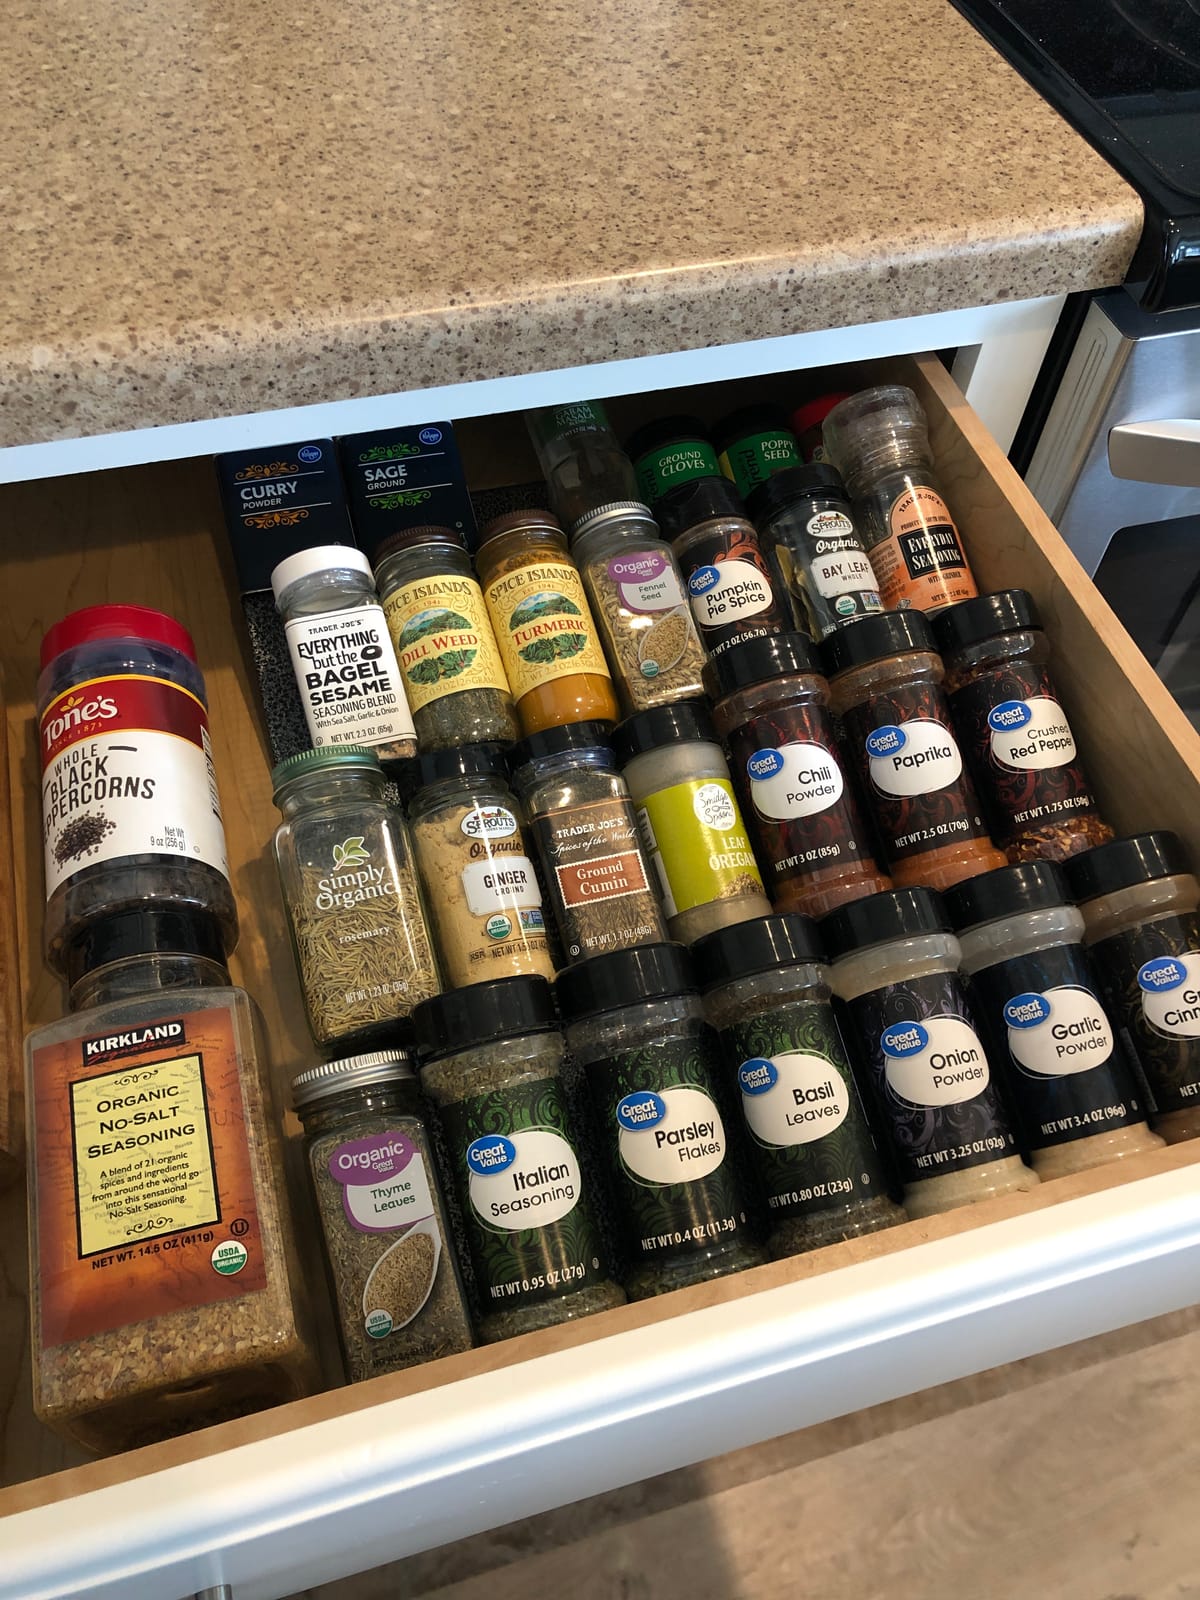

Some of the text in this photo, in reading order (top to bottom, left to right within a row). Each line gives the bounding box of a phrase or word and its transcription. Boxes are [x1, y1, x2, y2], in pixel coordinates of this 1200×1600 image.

[761, 440, 793, 452] POPPY
[764, 450, 790, 460] SEED
[659, 451, 701, 467] GROUND
[661, 459, 705, 477] CLOVES
[364, 465, 408, 481] SAGE
[240, 481, 297, 501] CURRY
[367, 479, 406, 490] GROUND
[243, 497, 282, 510] POWDER
[812, 520, 851, 534] SPROUTS
[816, 538, 859, 553] Organic
[614, 558, 659, 574] Organic
[822, 562, 869, 579] BAY LEAF
[412, 582, 472, 600] ISLANDS
[490, 568, 579, 604] SPICE ISLANDS
[638, 582, 666, 592] Fennel
[706, 581, 762, 606] Pumpkin
[641, 592, 661, 601] Seed
[708, 592, 766, 619] Pie Spice
[308, 620, 362, 635] TRADER JOE'S
[512, 620, 588, 646] TURMERIC
[741, 628, 768, 642] (56.7g)
[297, 629, 379, 658] EVERYTHING
[402, 634, 478, 668] DILL WEED
[313, 650, 358, 670] but the
[306, 660, 388, 690] BAGEL
[310, 678, 392, 706] SESAME
[313, 694, 396, 720] SEASONING BLEND
[993, 706, 1023, 723] Great
[44, 696, 118, 750] Tone's
[316, 719, 332, 729] With
[332, 717, 344, 726] Sea
[358, 710, 375, 721] Garlic
[376, 709, 381, 717] &
[381, 706, 399, 716] Onion
[356, 724, 393, 739] 2.3 (65g)
[870, 732, 897, 749] Great
[54, 744, 98, 776] WHOLE
[892, 745, 952, 772] Paprika
[1010, 742, 1037, 760] Red
[750, 754, 776, 772] Great
[51, 756, 109, 804] BLACK
[798, 766, 832, 786] Chili
[786, 784, 836, 804] Powder
[44, 776, 156, 845] PPERCORNS
[1045, 802, 1063, 814] 1.75
[164, 826, 185, 838] Net Wt
[466, 817, 515, 834] SPROUTS
[556, 818, 624, 840] TRADER JOE'S
[922, 818, 970, 840] 2.5 (70g)
[150, 837, 155, 847] 9
[156, 838, 164, 847] oz
[165, 837, 178, 850] (256
[470, 840, 522, 858] Organic
[551, 842, 582, 858] Spices
[612, 828, 636, 842] World
[722, 836, 746, 850] LEAF
[800, 844, 841, 864] 3 (85g)
[318, 864, 386, 893] Simply
[484, 870, 528, 888] GINGER
[576, 860, 624, 880] Ground
[316, 880, 400, 910] Organic
[580, 876, 628, 896] Cumin
[339, 925, 390, 944] rosemary
[612, 930, 624, 942] 1.7
[1142, 963, 1178, 982] Great
[368, 986, 382, 999] 1.23
[1008, 1000, 1041, 1018] Great
[885, 1027, 920, 1046] Great
[1051, 1018, 1102, 1040] Garlic
[86, 1023, 182, 1056] KIRKLAND
[1056, 1035, 1108, 1058] Powder
[929, 1048, 980, 1071] Onion
[740, 1065, 770, 1084] Great
[932, 1068, 984, 1089] Powder
[97, 1086, 180, 1113] ORGANIC
[792, 1081, 835, 1106] Basil
[621, 1098, 656, 1118] Great
[786, 1102, 840, 1127] Leaves
[1074, 1102, 1126, 1128] 3.4 (96g)
[100, 1106, 180, 1134] NO-SALT
[88, 1124, 196, 1159] SEASONING
[655, 1121, 714, 1149] Parsley
[338, 1142, 404, 1170] Organic
[471, 1142, 505, 1162] Great
[678, 1140, 721, 1162] Flakes
[950, 1134, 1006, 1160] 3.25 (92g)
[100, 1170, 107, 1178] A
[109, 1164, 132, 1177] blend
[134, 1160, 143, 1170] of
[158, 1152, 188, 1168] organic
[480, 1155, 508, 1168] Value
[92, 1170, 200, 1202] from around the world go
[100, 1162, 190, 1190] spices and ingredients
[512, 1162, 570, 1192] Italian
[105, 1184, 188, 1210] into this sensational
[370, 1181, 412, 1200] Thyme
[491, 1184, 575, 1217] Seasoning
[792, 1178, 854, 1204] 0.80 (23g)
[110, 1195, 187, 1220] No-Salt Seasoning.
[374, 1194, 416, 1214] Leaves
[642, 1217, 736, 1251] NET WT 0.4 (11.3g)
[92, 1232, 214, 1270] NET 14.5 OZ (411g)
[218, 1246, 240, 1258] USDA
[216, 1255, 244, 1268] ORGANIC
[490, 1264, 586, 1299] NET WT 0.95 (27g)
